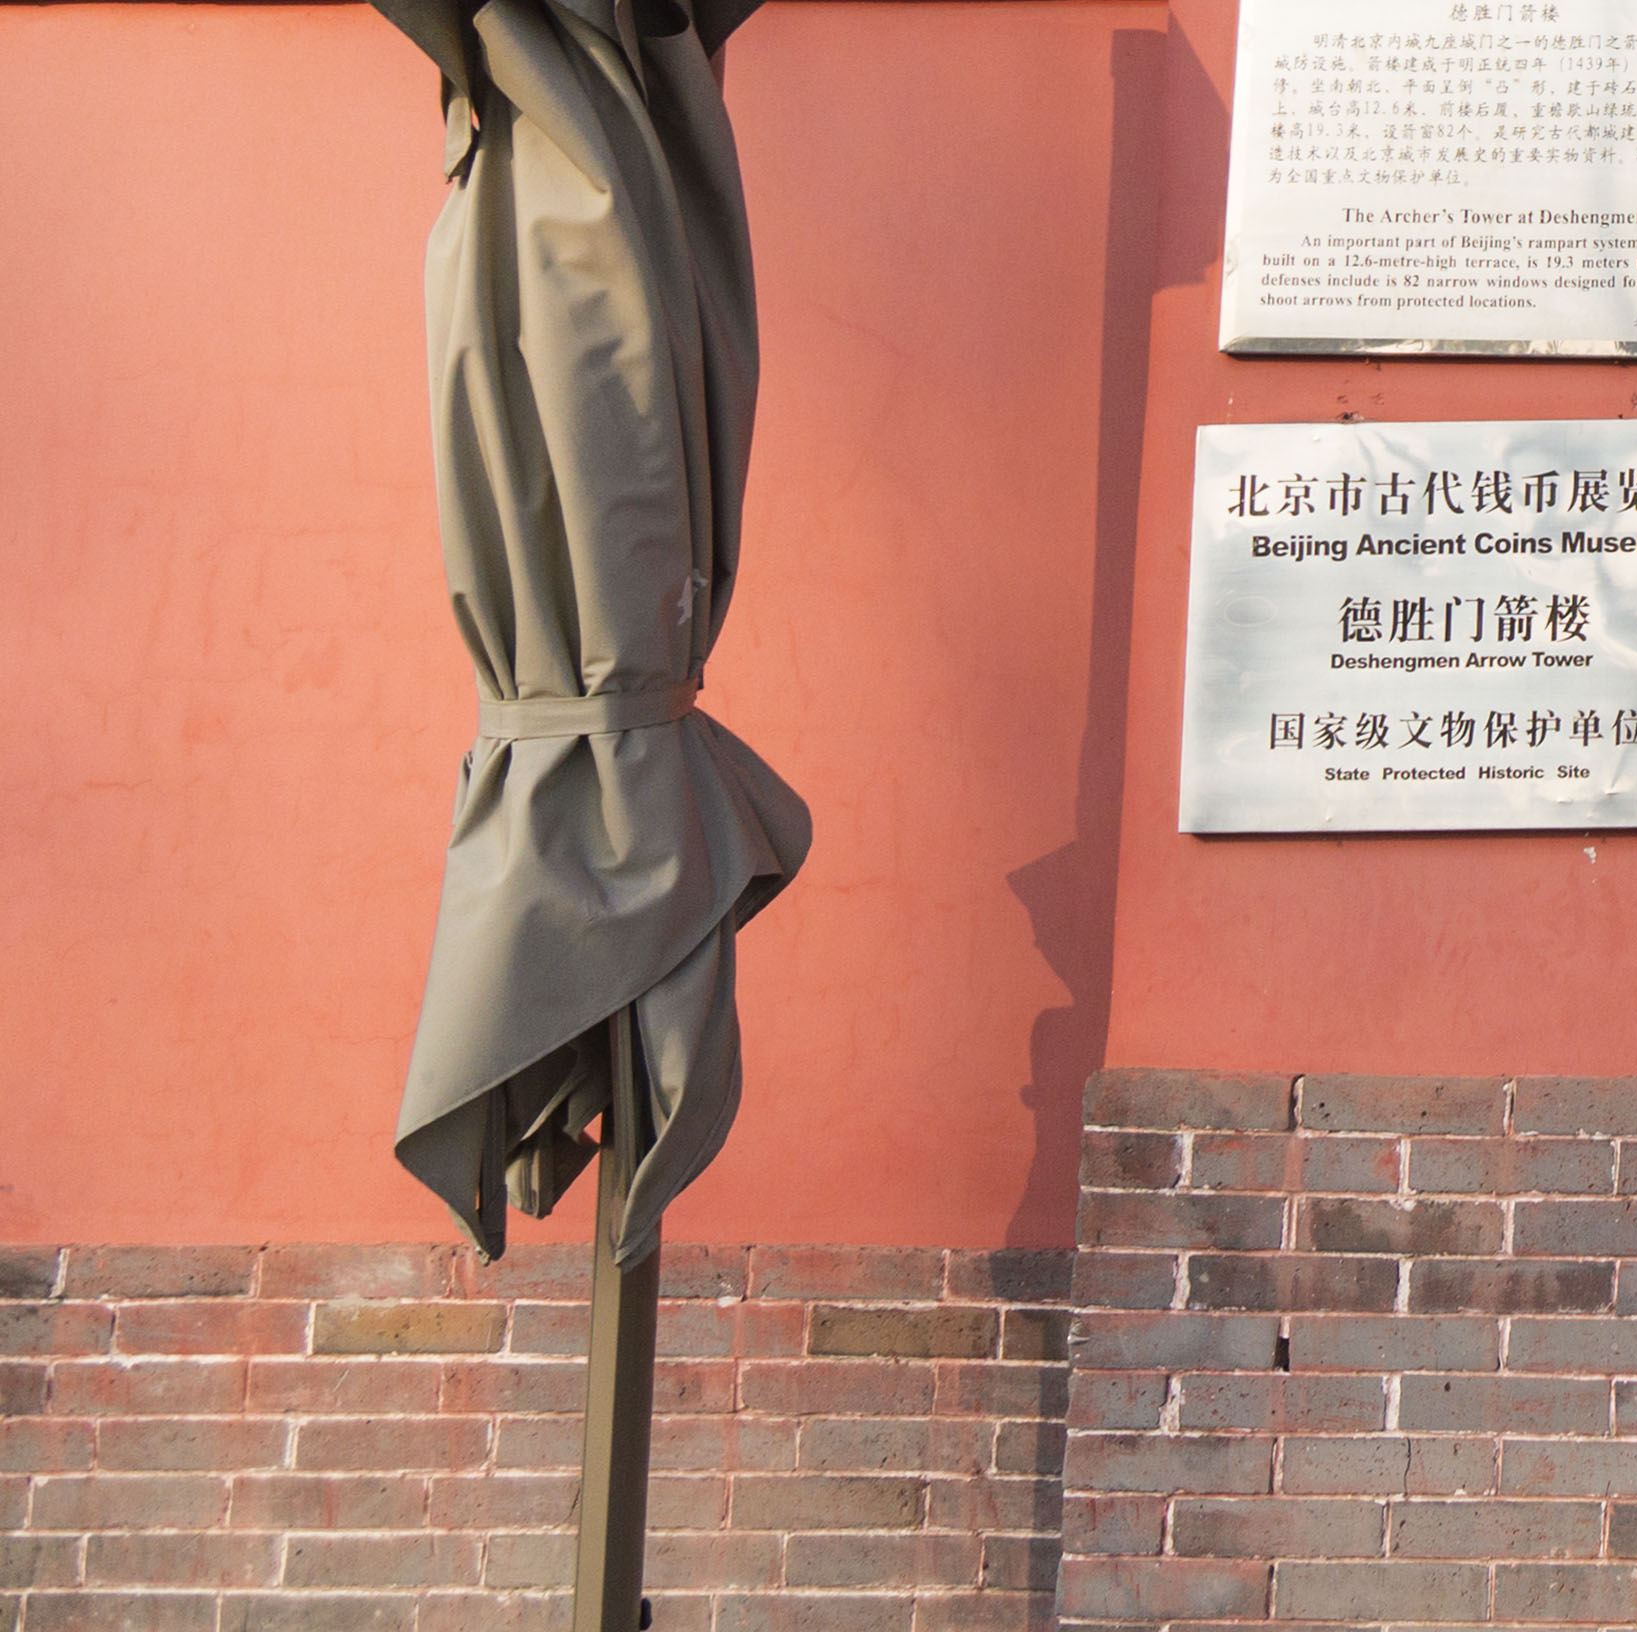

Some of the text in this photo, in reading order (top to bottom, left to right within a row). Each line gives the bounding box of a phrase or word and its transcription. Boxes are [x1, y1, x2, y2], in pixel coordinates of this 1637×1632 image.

[1449, 2, 1560, 22] 德胜门箭楼
[1343, 208, 1374, 224] The
[1460, 209, 1513, 224] Tower
[1518, 211, 1534, 225] at
[1301, 235, 1321, 248] An
[1328, 234, 1400, 250] important
[1405, 236, 1436, 251] part
[1441, 235, 1457, 248] of
[1527, 237, 1587, 252] rampart
[1262, 254, 1295, 266] built
[1303, 256, 1320, 267] on
[1328, 257, 1336, 267] a
[1345, 254, 1457, 270] 12.6-metre-high
[1465, 255, 1520, 269] terrace,
[1527, 256, 1538, 268] is
[1546, 256, 1574, 268] 19.3
[1582, 257, 1629, 268] meters
[1261, 273, 1321, 287] defenses
[1328, 273, 1380, 287] include
[1386, 274, 1397, 287] is
[1403, 275, 1420, 287] 82
[1427, 277, 1479, 288] narrow
[1487, 275, 1548, 288] windows
[1554, 275, 1616, 291] designed
[1260, 293, 1536, 310] shoot arrows from protected locations.
[1251, 535, 1348, 563] Beijing
[1356, 533, 1466, 557] Ancient
[1473, 531, 1553, 555] Coins
[1338, 595, 1592, 644] 德胜门箭楼
[1330, 651, 1594, 673] Deshengmen Arrow Tower
[1324, 765, 1591, 781] State Protected Historic Site
